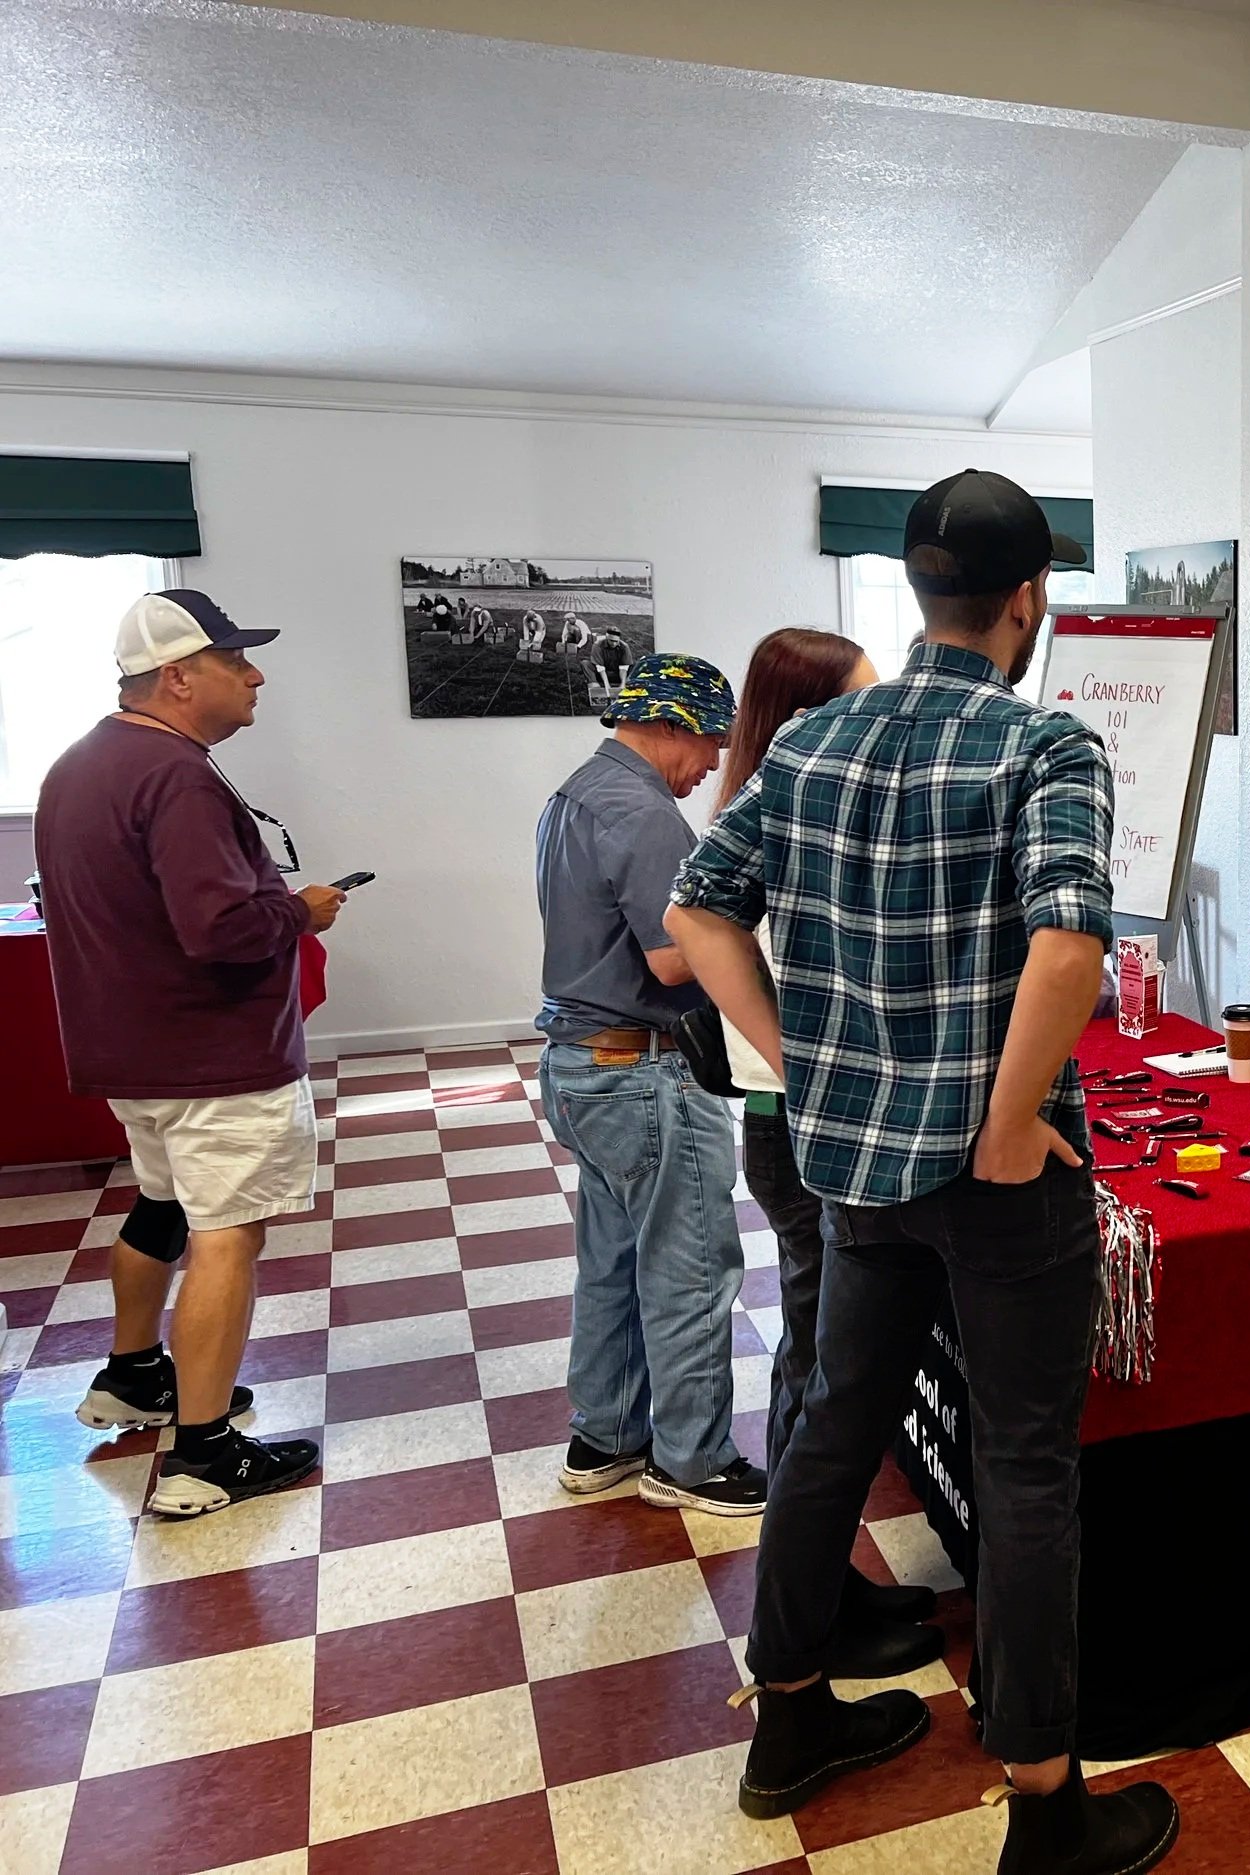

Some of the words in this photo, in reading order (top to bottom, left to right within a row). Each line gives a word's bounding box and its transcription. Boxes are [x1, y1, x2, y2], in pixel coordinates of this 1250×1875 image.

[1082, 672, 1166, 704] CRANBERRY
[1108, 711, 1128, 728] 101
[1108, 733, 1119, 752] &
[1120, 826, 1164, 852] STATE
[914, 1368, 939, 1418] ool
[942, 1404, 958, 1444] of
[922, 1424, 970, 1531] Science
